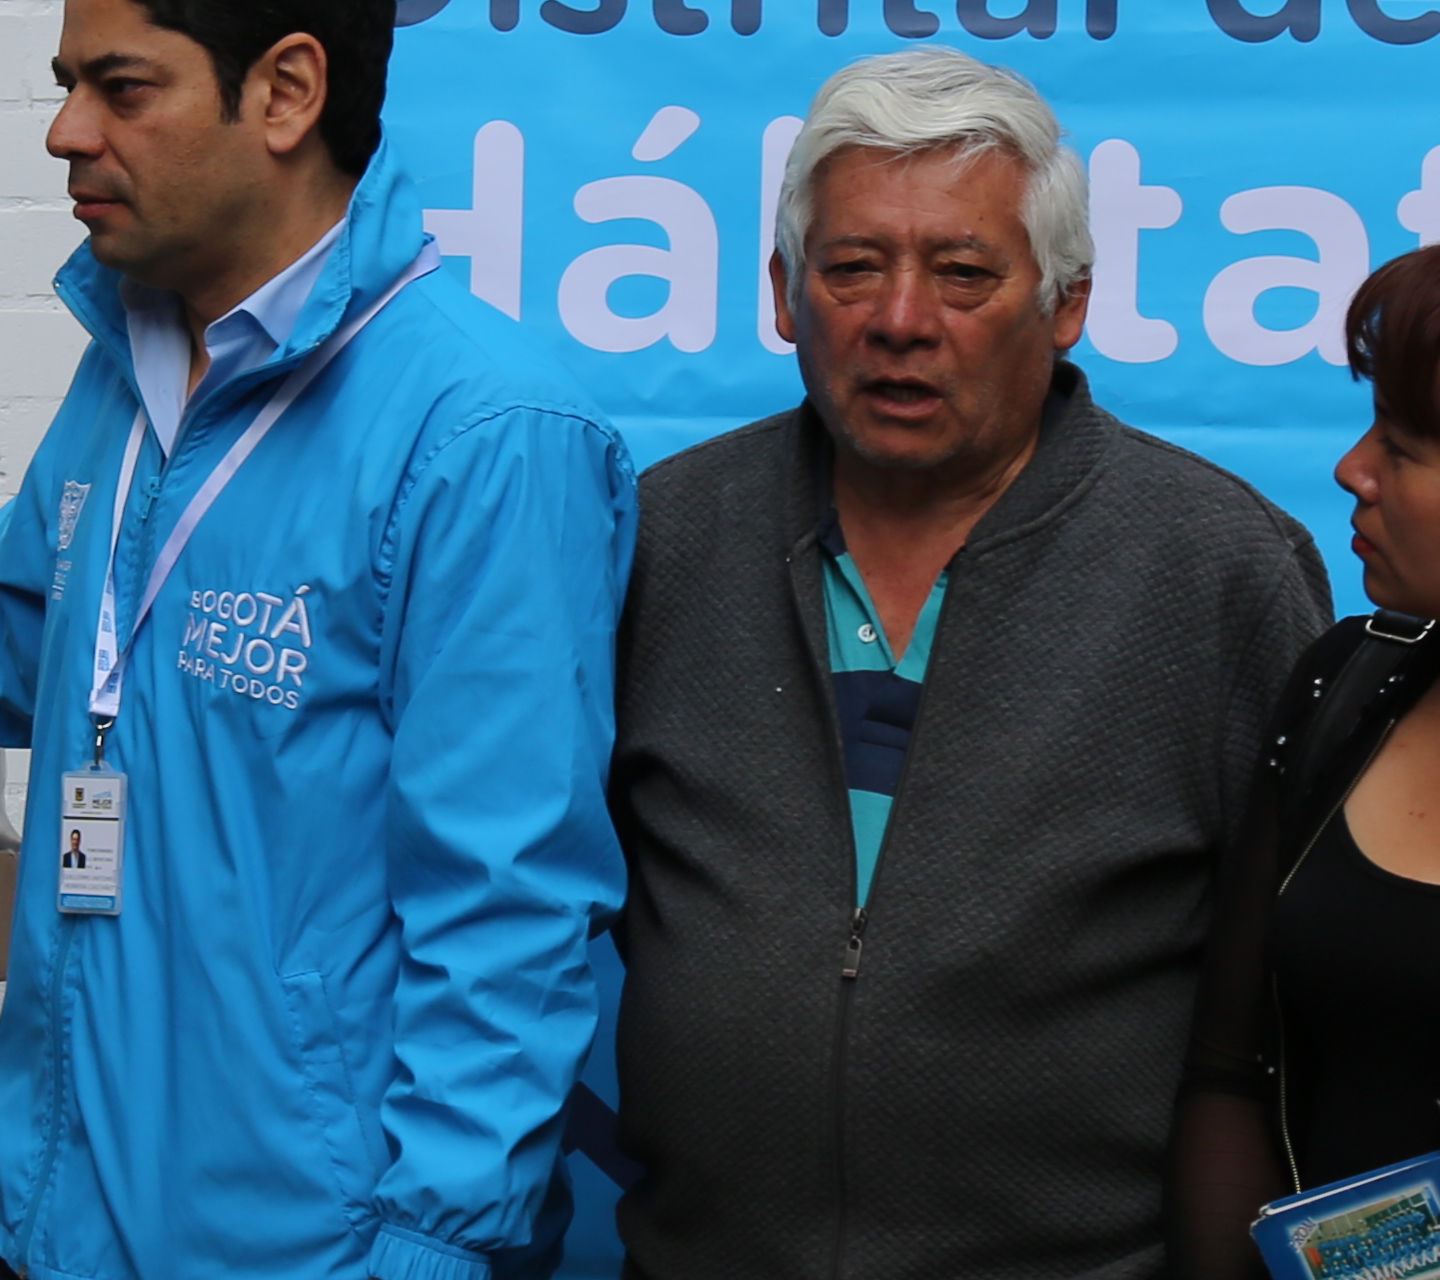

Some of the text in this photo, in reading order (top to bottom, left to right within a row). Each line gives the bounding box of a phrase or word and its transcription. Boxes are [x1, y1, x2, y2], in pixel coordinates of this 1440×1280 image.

[190, 584, 312, 648] BOGOTÁ
[177, 650, 300, 710] PARA TODOS
[182, 612, 308, 687] MEJOR
